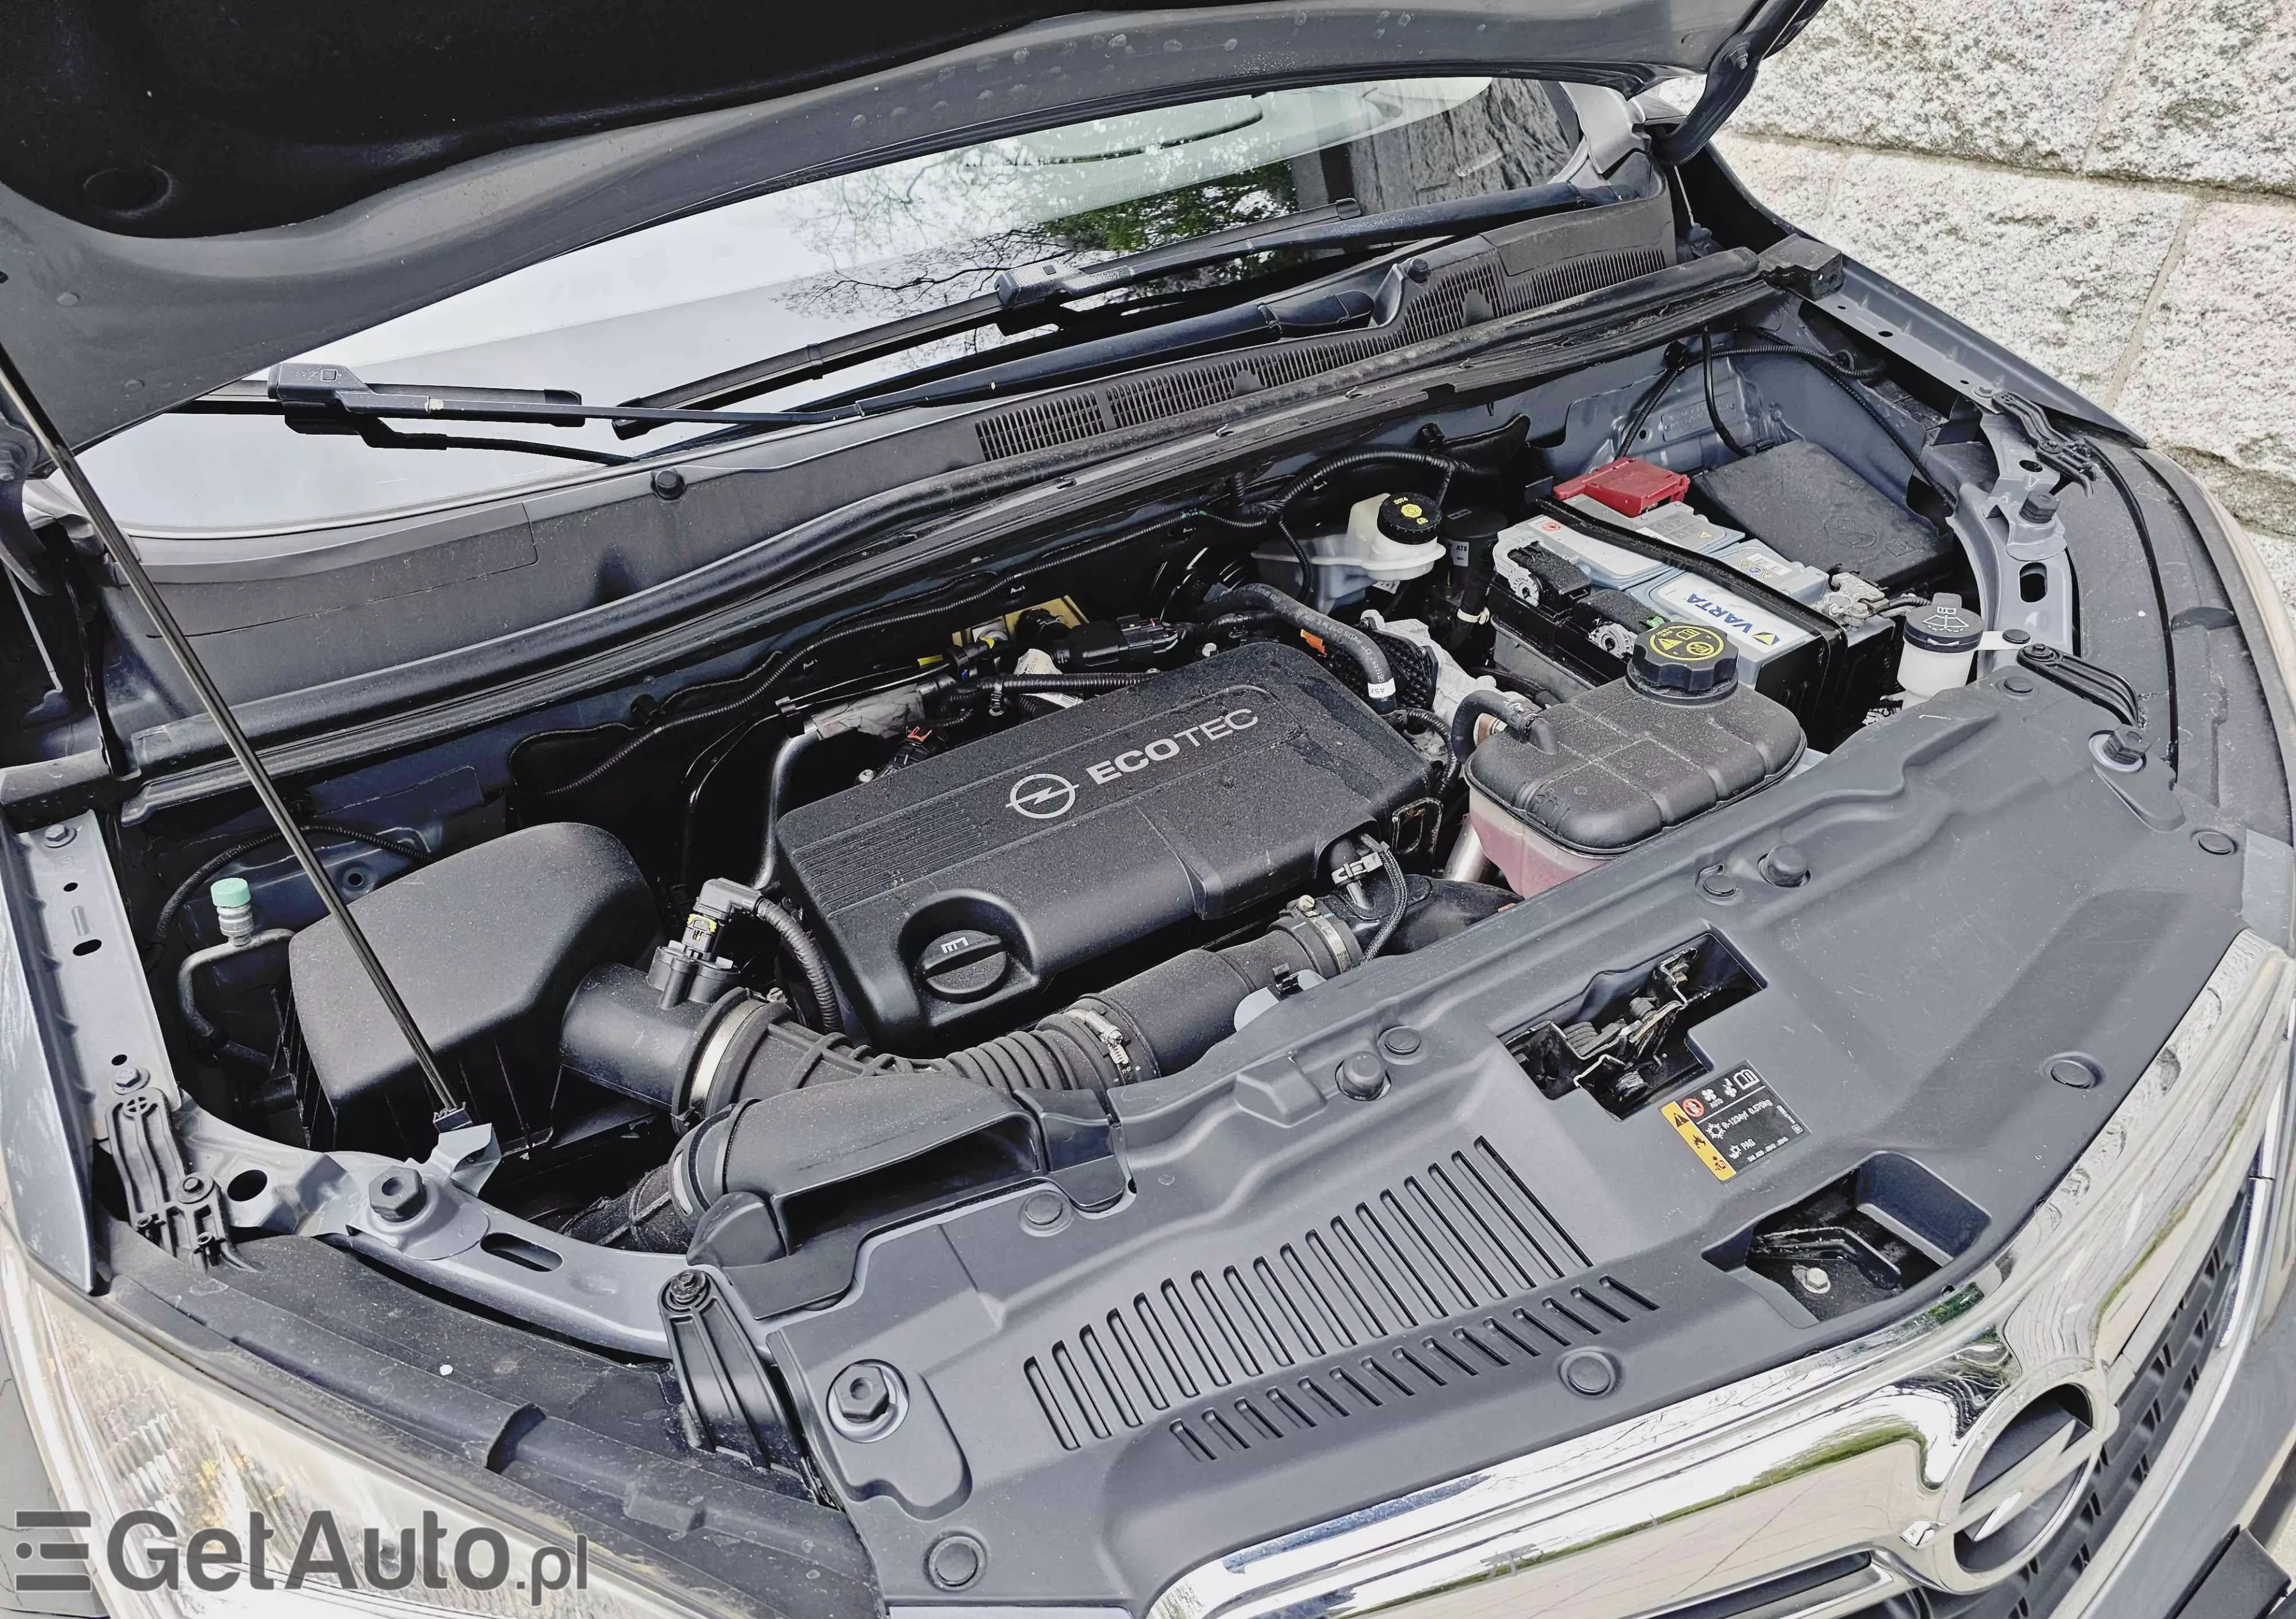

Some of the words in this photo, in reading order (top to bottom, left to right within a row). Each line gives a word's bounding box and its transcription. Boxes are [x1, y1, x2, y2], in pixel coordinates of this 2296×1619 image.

[1687, 593, 1753, 633] VARTA
[1086, 708, 1259, 785] ECOTEC
[1709, 1098, 1724, 1108] AUTO
[1741, 1139, 1756, 1150] PAG
